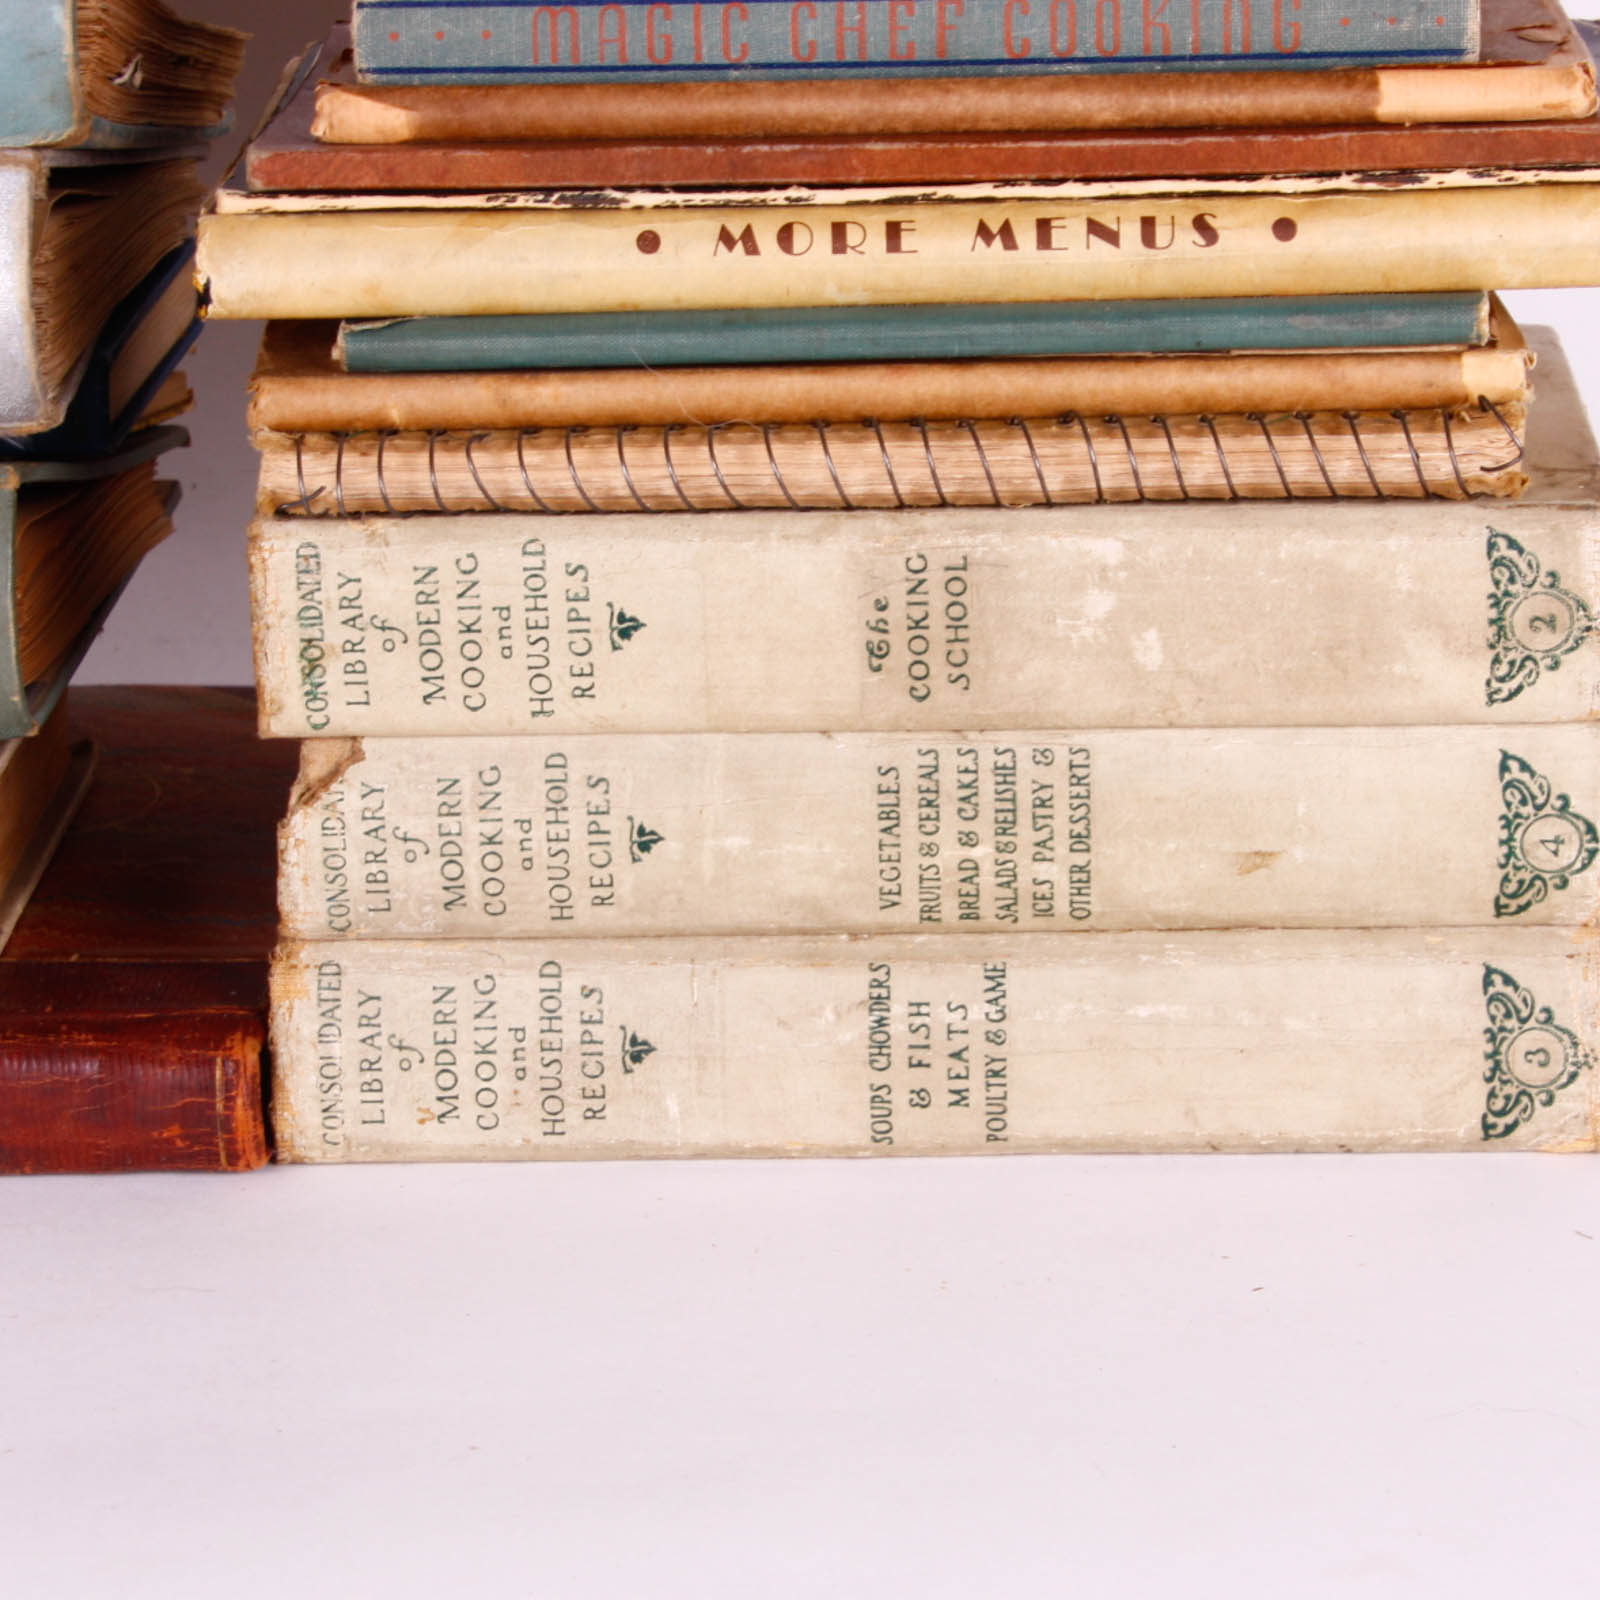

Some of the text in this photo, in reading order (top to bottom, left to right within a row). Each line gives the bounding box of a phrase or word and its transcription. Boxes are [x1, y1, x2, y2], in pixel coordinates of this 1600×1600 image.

[532, 0, 1303, 66] MAGIC CHEF COOKING
[714, 212, 1221, 257] MORE MENUS
[296, 541, 331, 730] CONSOLIDATED
[338, 571, 370, 708] LIBRARY
[371, 614, 407, 653] of
[414, 565, 446, 705] MODERN
[456, 552, 486, 712] COOKING
[492, 604, 513, 659] and
[522, 537, 554, 718] HOUSEHOLD
[565, 563, 596, 699] RECIPES
[866, 595, 890, 673] The
[906, 552, 931, 703] COOKING
[945, 555, 970, 690] SCHOOL
[1529, 611, 1558, 634] 2
[361, 782, 391, 914] LIBRARY
[393, 826, 430, 863] of
[436, 777, 465, 912] MODERN
[479, 765, 507, 917] COOKING
[514, 818, 534, 871] and
[545, 752, 574, 921] HOUSEHOLD
[586, 775, 615, 907] RECIPES
[878, 765, 902, 911] VEGETABLES
[917, 747, 942, 925] FRUITS & CEREALS
[957, 747, 981, 921] BREAD & CAKES
[994, 746, 1018, 924] SALADS & RELISHES
[1032, 747, 1055, 919] ICES PASTRY &
[1068, 746, 1092, 921] OTHER DESSERTS
[1538, 832, 1566, 858] 4
[357, 988, 385, 1125] LIBRARY
[388, 1034, 424, 1072] of
[433, 986, 461, 1124] MODERN
[474, 973, 500, 1131] COOKING
[508, 1025, 527, 1082] and
[538, 960, 566, 1137] HOUSEHOLD
[577, 985, 607, 1122] RECIPES
[868, 962, 893, 1145] SOUPS CHOWDERS
[908, 1000, 932, 1110] & FISH
[947, 1000, 970, 1109] MEATS
[984, 960, 1009, 1143] POULTRY & GAME
[1523, 1047, 1550, 1070] 3
